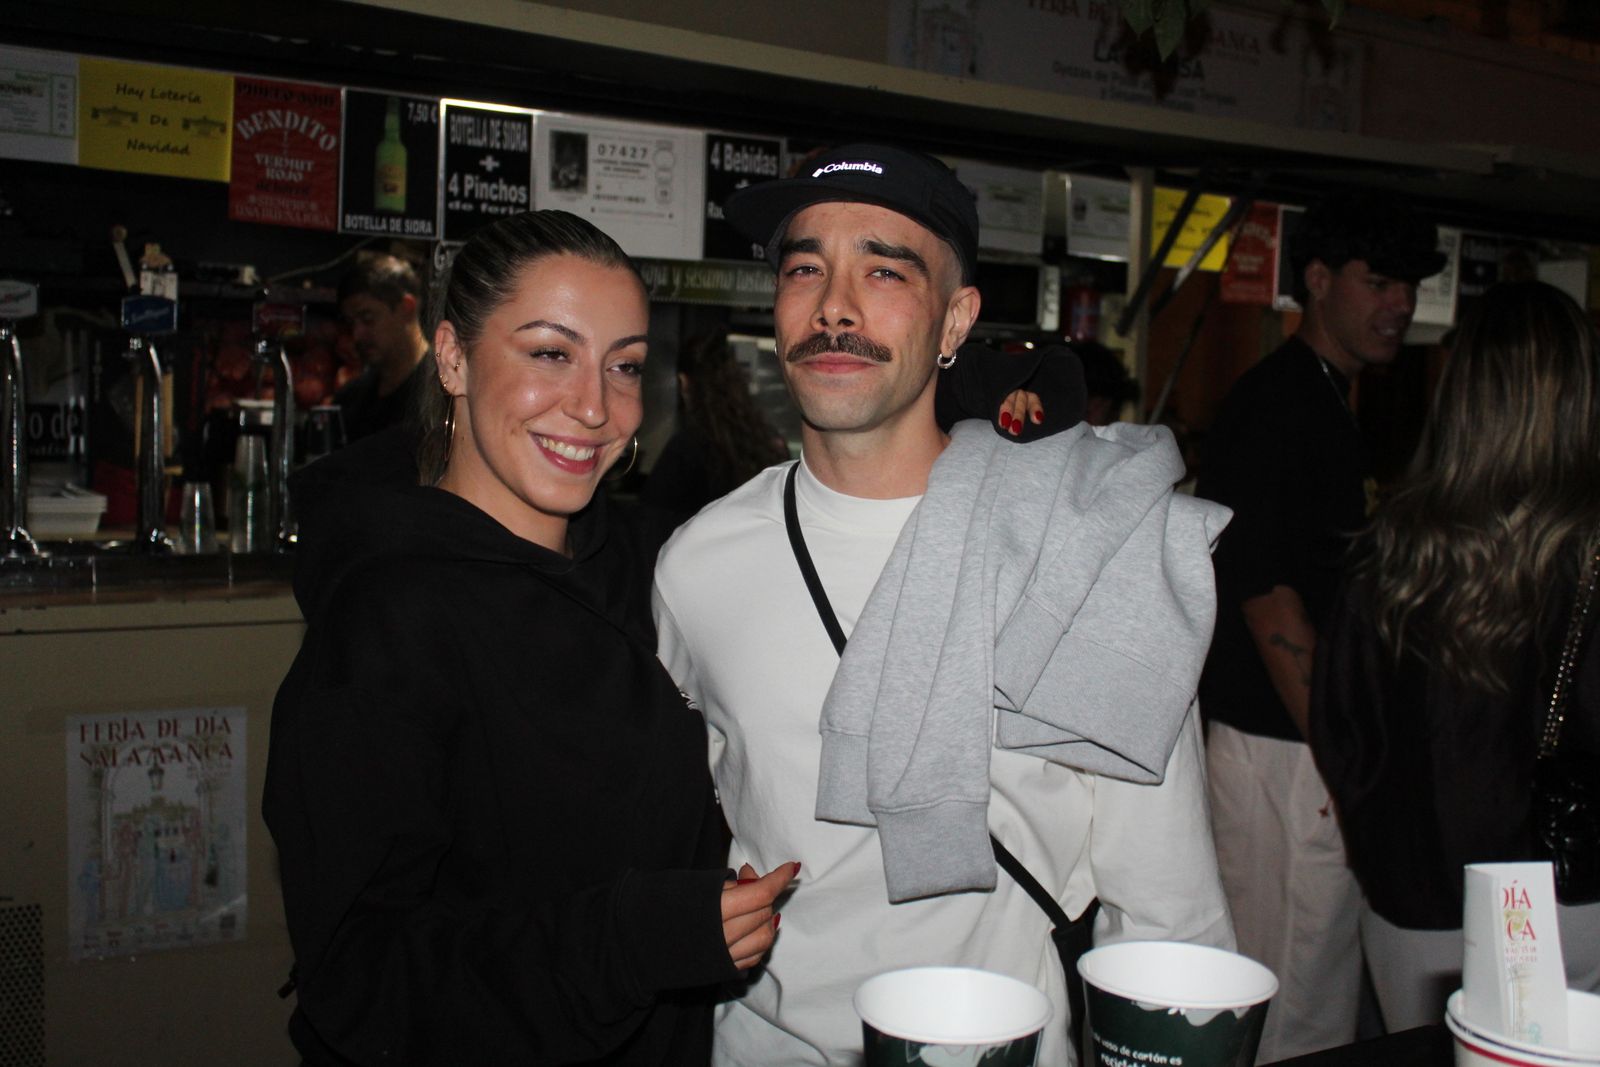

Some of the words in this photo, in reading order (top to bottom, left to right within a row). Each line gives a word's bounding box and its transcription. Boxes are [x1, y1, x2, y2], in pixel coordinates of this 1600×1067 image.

[115, 83, 144, 99] Hay
[150, 114, 170, 127] De
[236, 108, 337, 152] BENDITO
[449, 113, 487, 148] BOTELLA
[489, 118, 501, 149] DE
[503, 119, 528, 152] SIDRA
[126, 138, 191, 155] Navidad
[710, 140, 721, 170] 4
[723, 143, 779, 176] Bebidas
[823, 161, 883, 175] Columbia
[265, 168, 305, 183] ROJO
[448, 172, 460, 196] 4
[463, 174, 528, 204] Pinchos
[345, 213, 387, 231] BOTELLA
[389, 216, 402, 232] DE
[404, 219, 433, 234] SIDRA
[158, 718, 180, 738] DE
[80, 742, 233, 768] SALAMANCA
[1120, 1044, 1131, 1057] de
[1132, 1049, 1168, 1065] cartón
[1169, 1056, 1183, 1066] es
